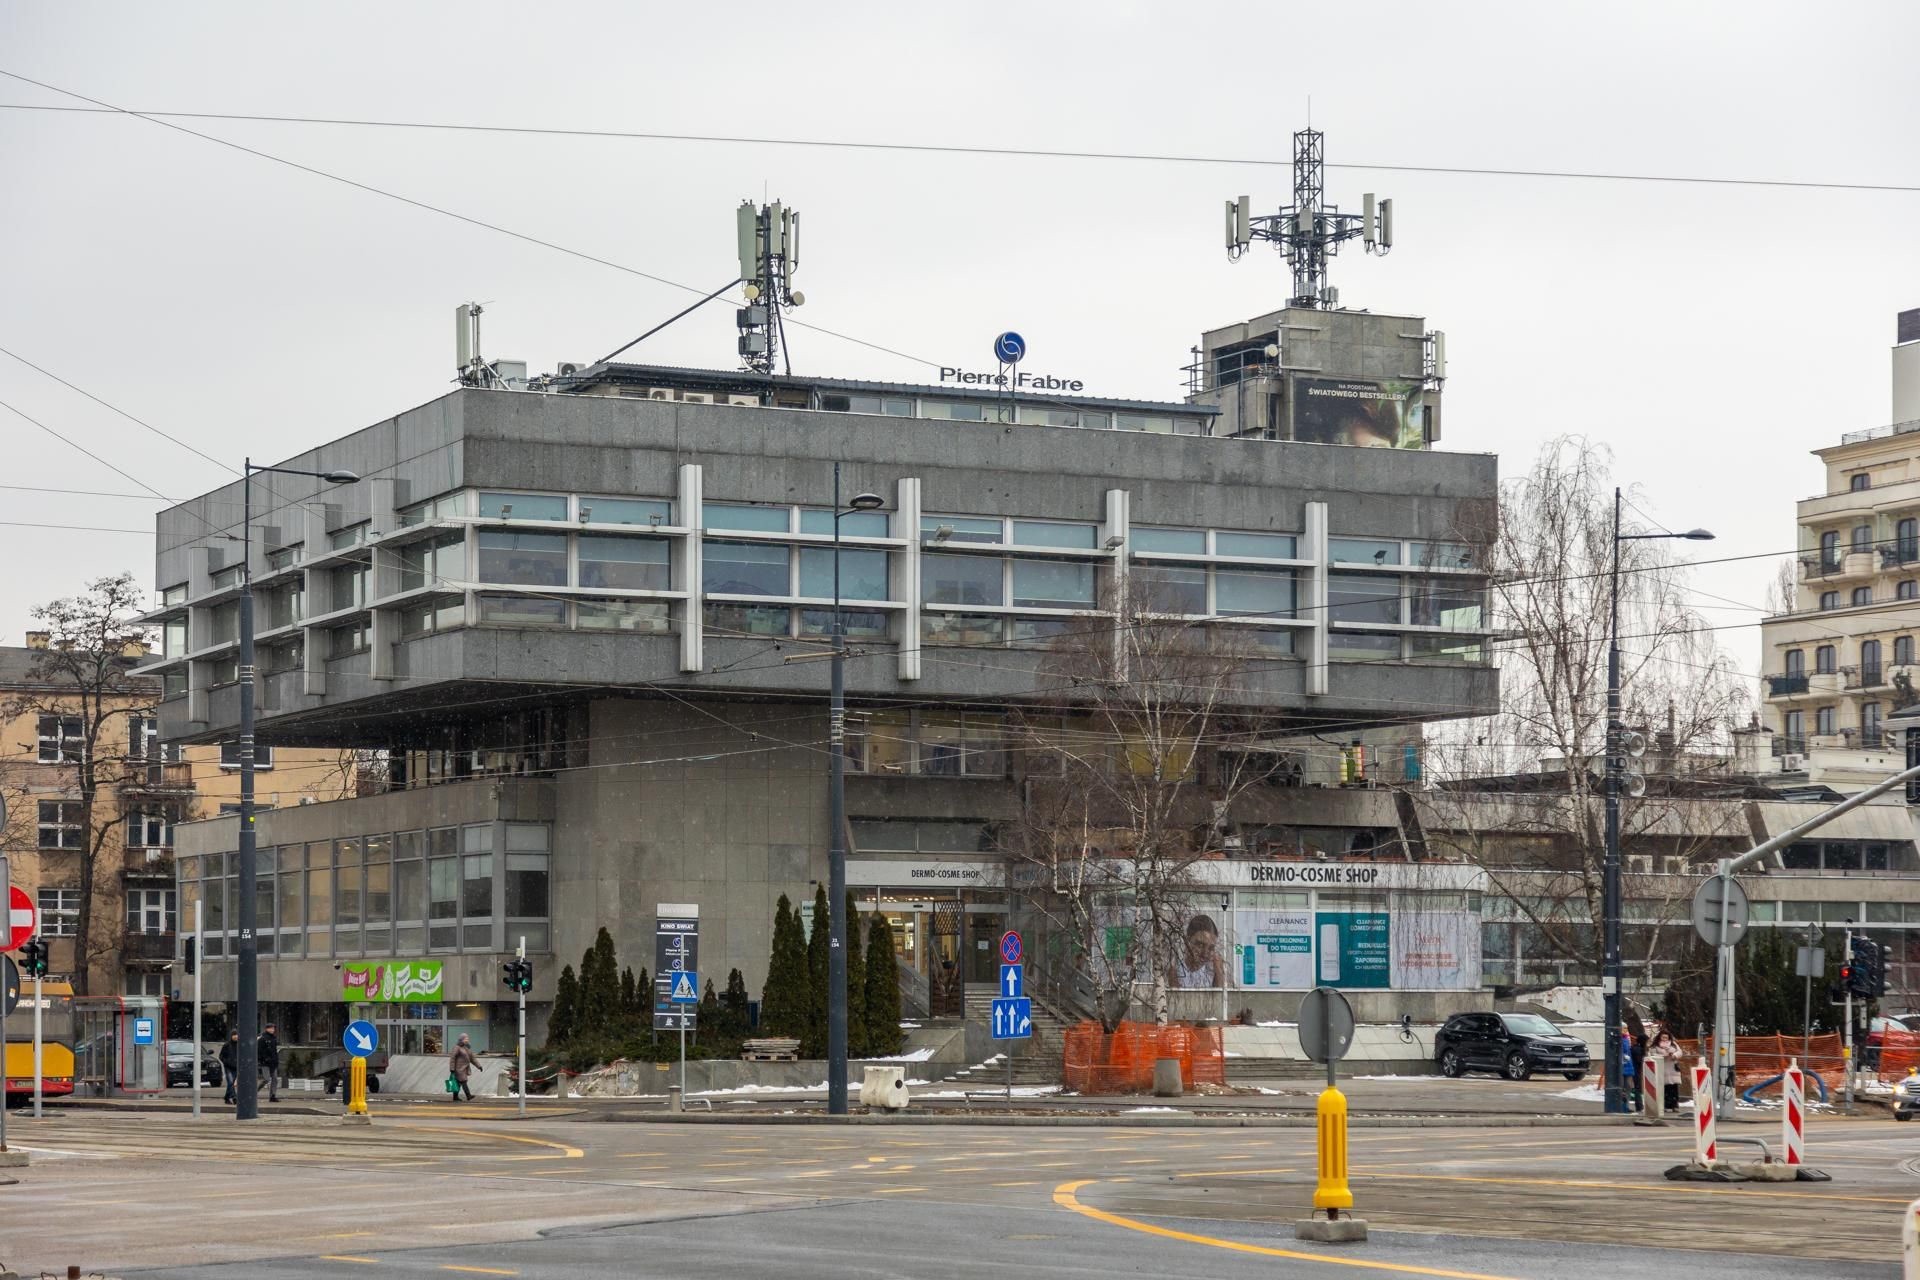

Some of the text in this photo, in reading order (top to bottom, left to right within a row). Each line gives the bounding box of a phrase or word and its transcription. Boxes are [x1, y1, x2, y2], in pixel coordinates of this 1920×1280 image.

[940, 367, 1083, 391] Pierre Fabre
[1308, 387, 1407, 400] ŚWIATOWEGO BESTSELLERA
[911, 869, 980, 879] DERMO-COSME SHOP
[1251, 866, 1378, 883] DERMO-COSME SHOP
